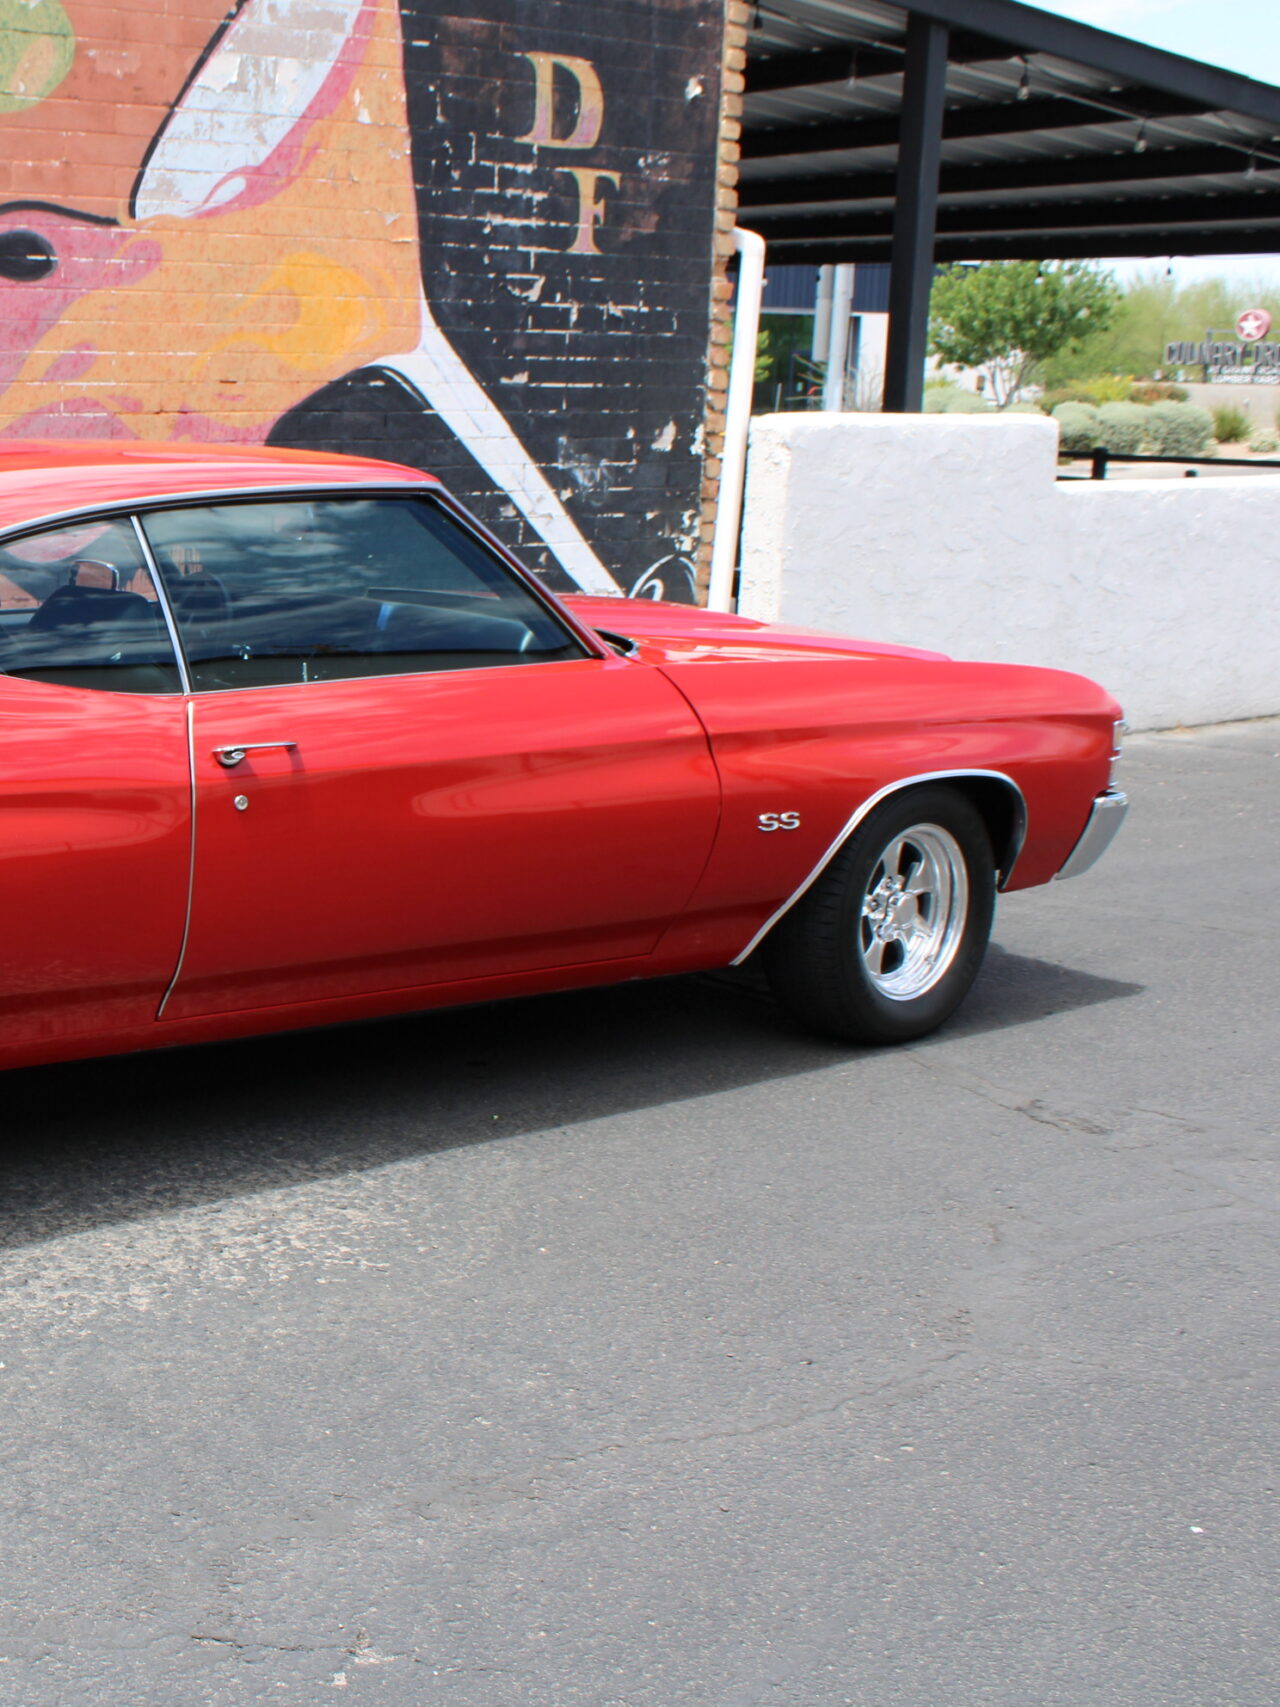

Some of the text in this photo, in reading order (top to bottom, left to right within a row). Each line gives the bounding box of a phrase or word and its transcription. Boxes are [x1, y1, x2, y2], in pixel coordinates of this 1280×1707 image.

[514, 52, 604, 149] D
[560, 167, 621, 254] F
[757, 811, 800, 832] SS
